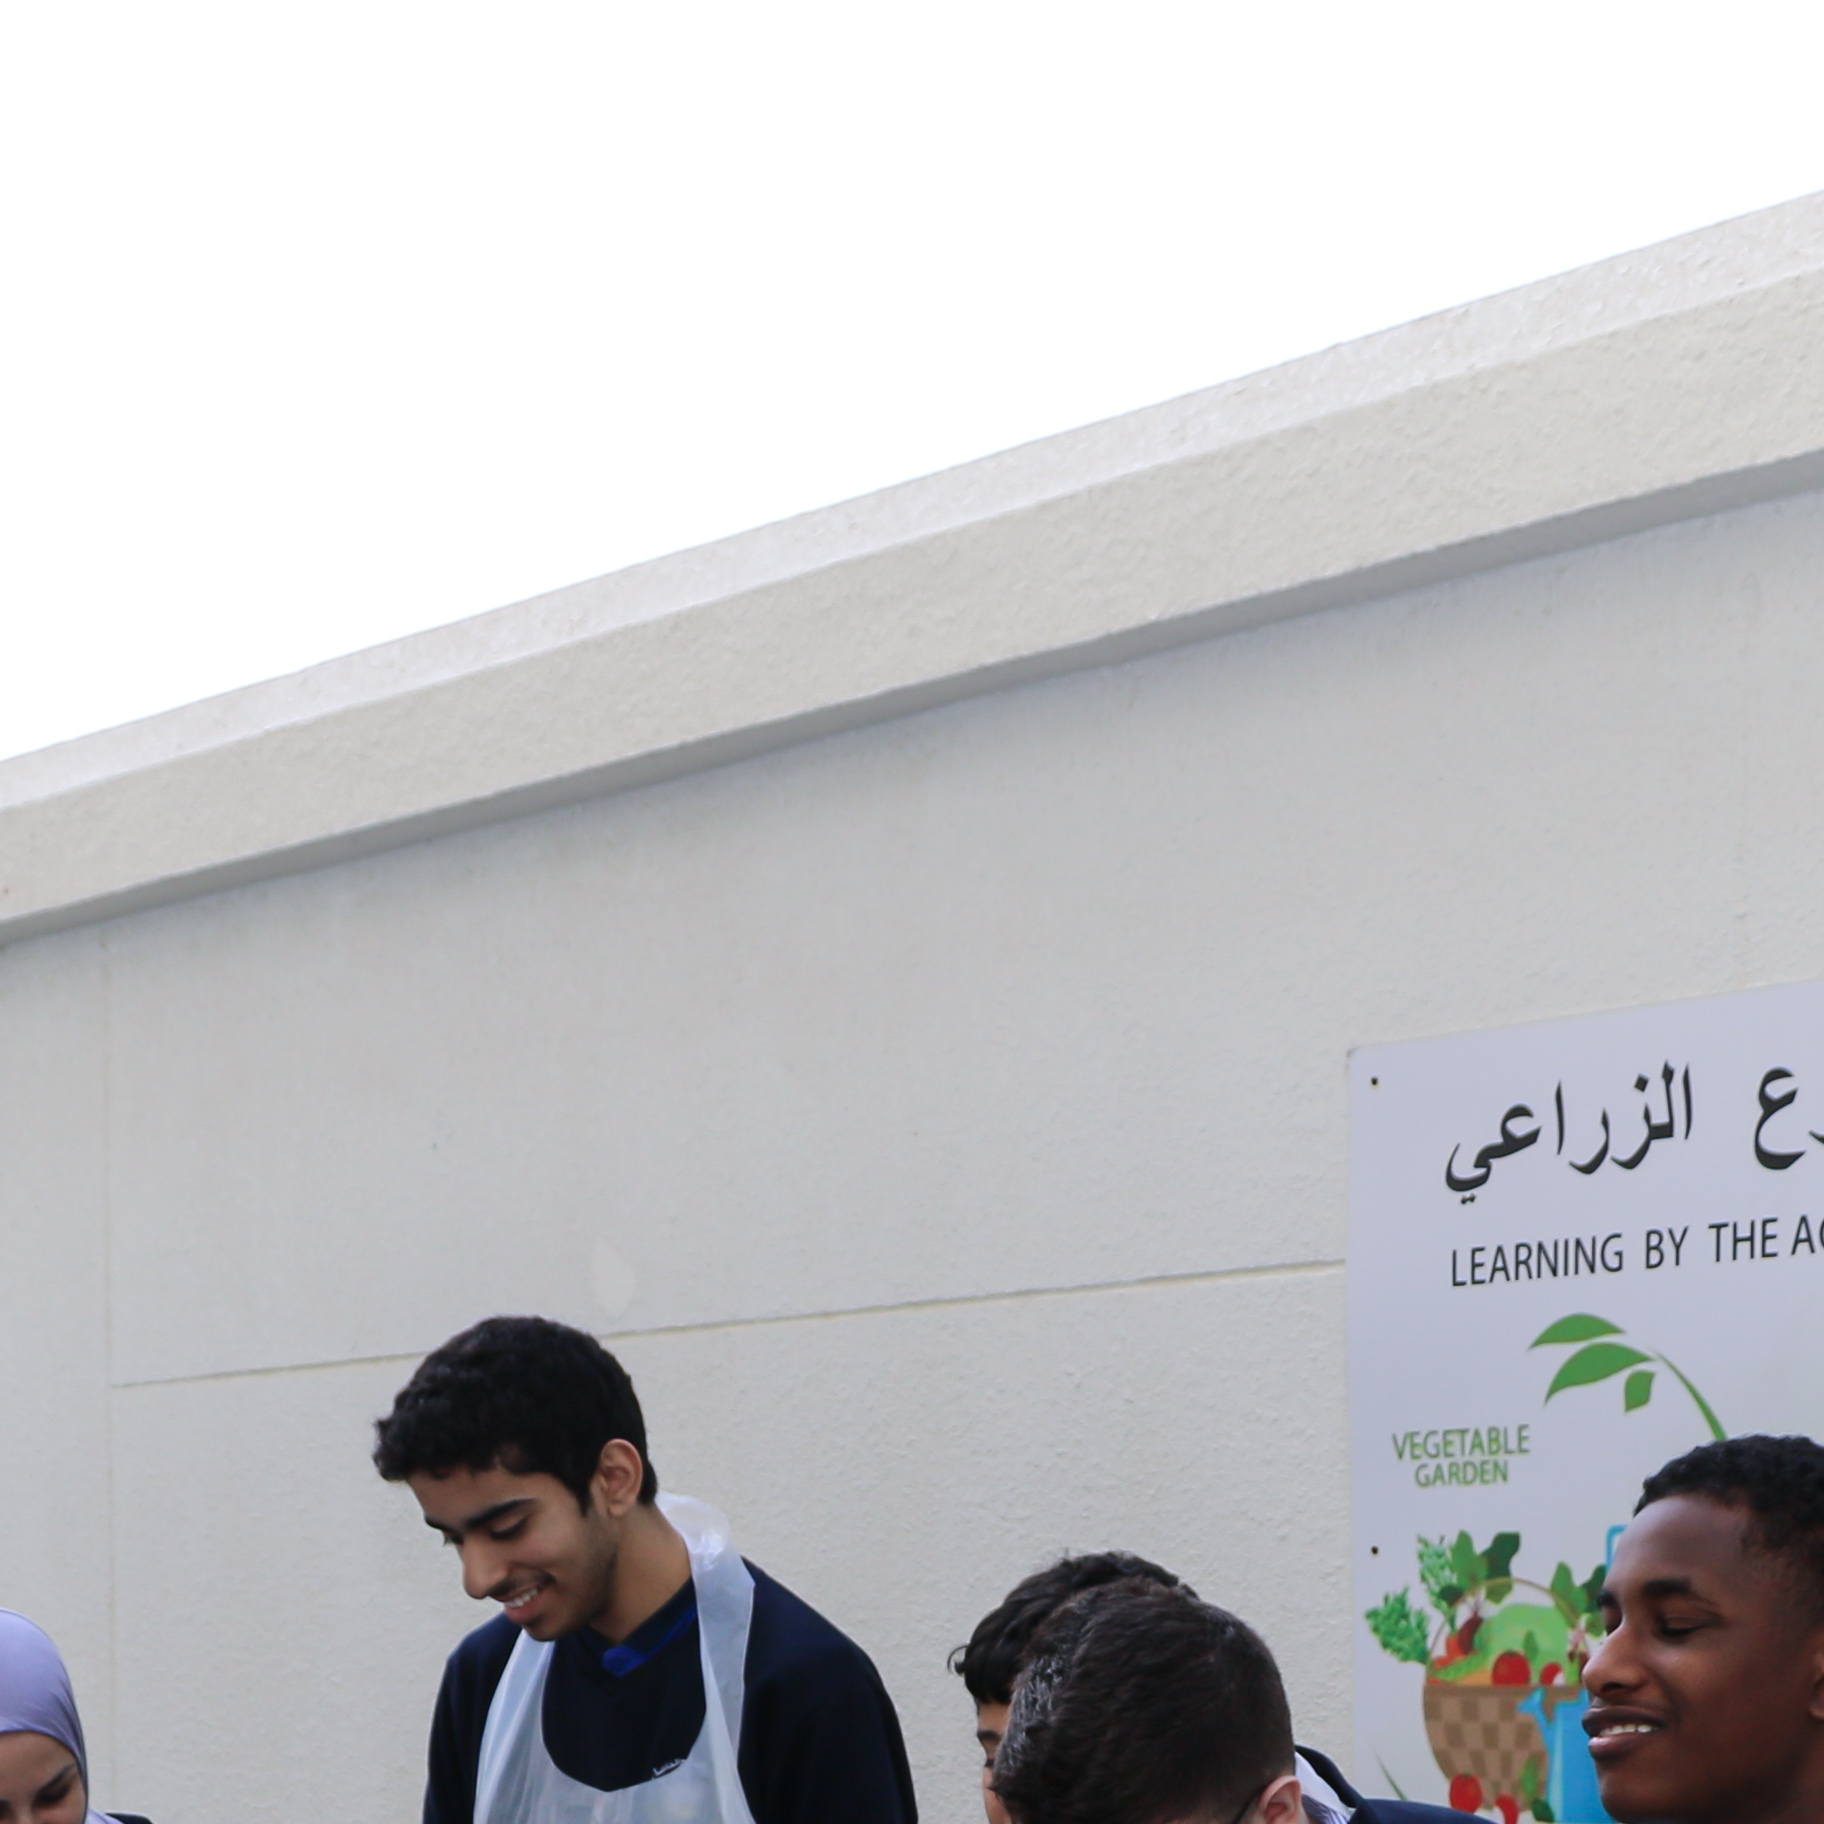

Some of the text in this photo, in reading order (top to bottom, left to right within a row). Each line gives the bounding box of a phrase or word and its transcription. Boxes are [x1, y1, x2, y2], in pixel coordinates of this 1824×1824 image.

[1445, 1061, 1693, 1206] الزراعي
[1451, 1232, 1624, 1287] LEARNING
[1645, 1226, 1689, 1270] BY
[1708, 1217, 1779, 1263] THE
[1392, 1424, 1530, 1461] VEGETABLE
[1414, 1459, 1509, 1489] GARDEN
